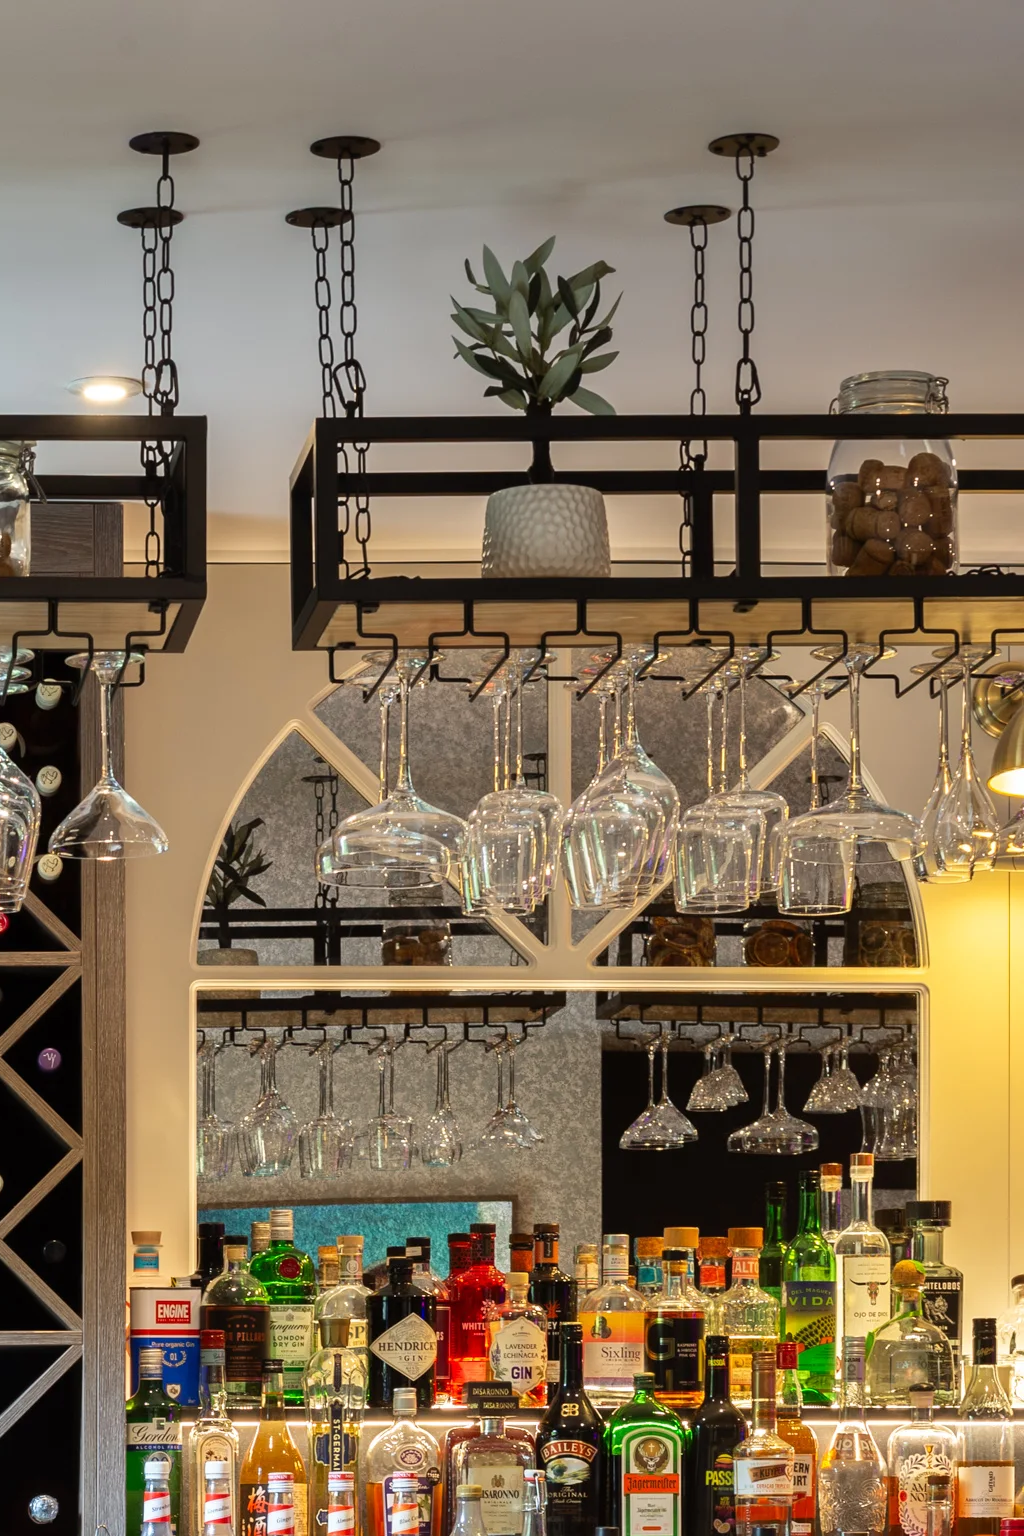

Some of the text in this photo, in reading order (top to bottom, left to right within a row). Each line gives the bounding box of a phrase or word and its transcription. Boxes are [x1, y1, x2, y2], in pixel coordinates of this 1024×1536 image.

[734, 1261, 759, 1273] ALTO
[788, 1296, 834, 1306] VIDA
[157, 1304, 189, 1319] ENGINE
[601, 1347, 641, 1362] Sixling
[511, 1366, 532, 1379] GIN
[472, 1387, 509, 1395] DISARONNO
[333, 1418, 342, 1471] ST-GERMAI
[543, 1442, 593, 1458] BAILEYS
[627, 1477, 677, 1491] Jägermeister
[482, 1489, 519, 1499] ISARONNO
